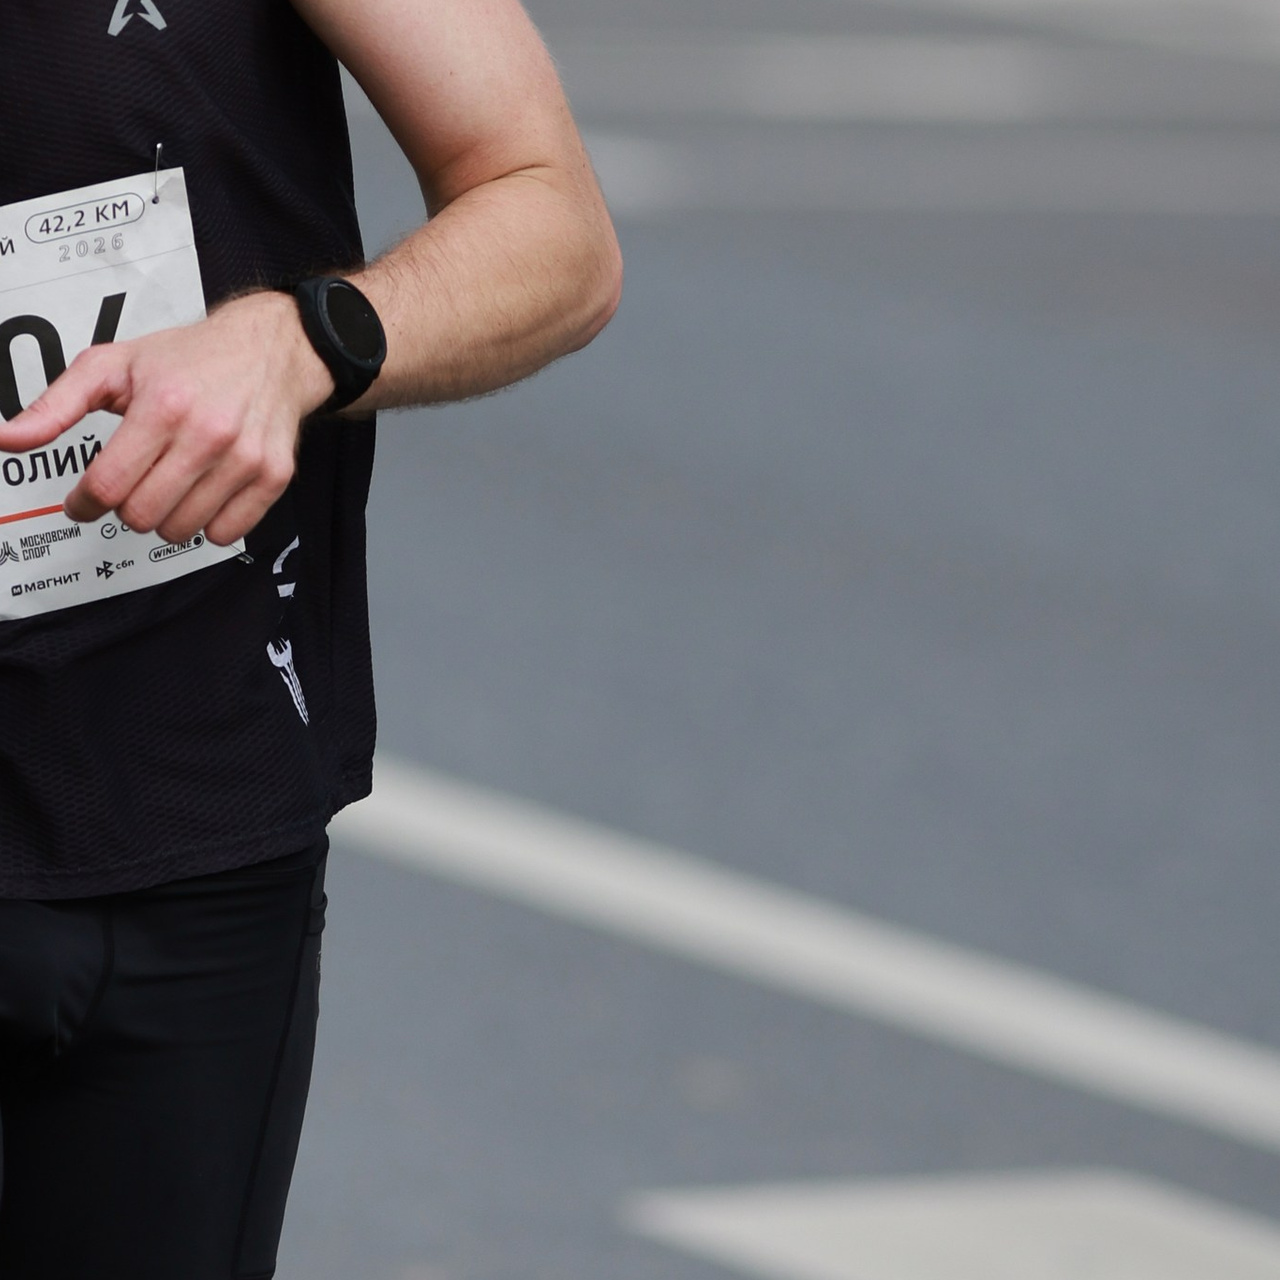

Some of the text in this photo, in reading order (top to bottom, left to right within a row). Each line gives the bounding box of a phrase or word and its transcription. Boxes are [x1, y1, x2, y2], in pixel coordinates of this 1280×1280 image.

[38, 210, 86, 234] 42,2
[58, 233, 124, 263] 2026
[19, 522, 82, 549] МОСКОВСКИЙ
[22, 544, 51, 561] СПОРТ
[153, 540, 192, 560] WINLINE
[115, 559, 135, 570] сбп
[24, 572, 81, 593] магнит
